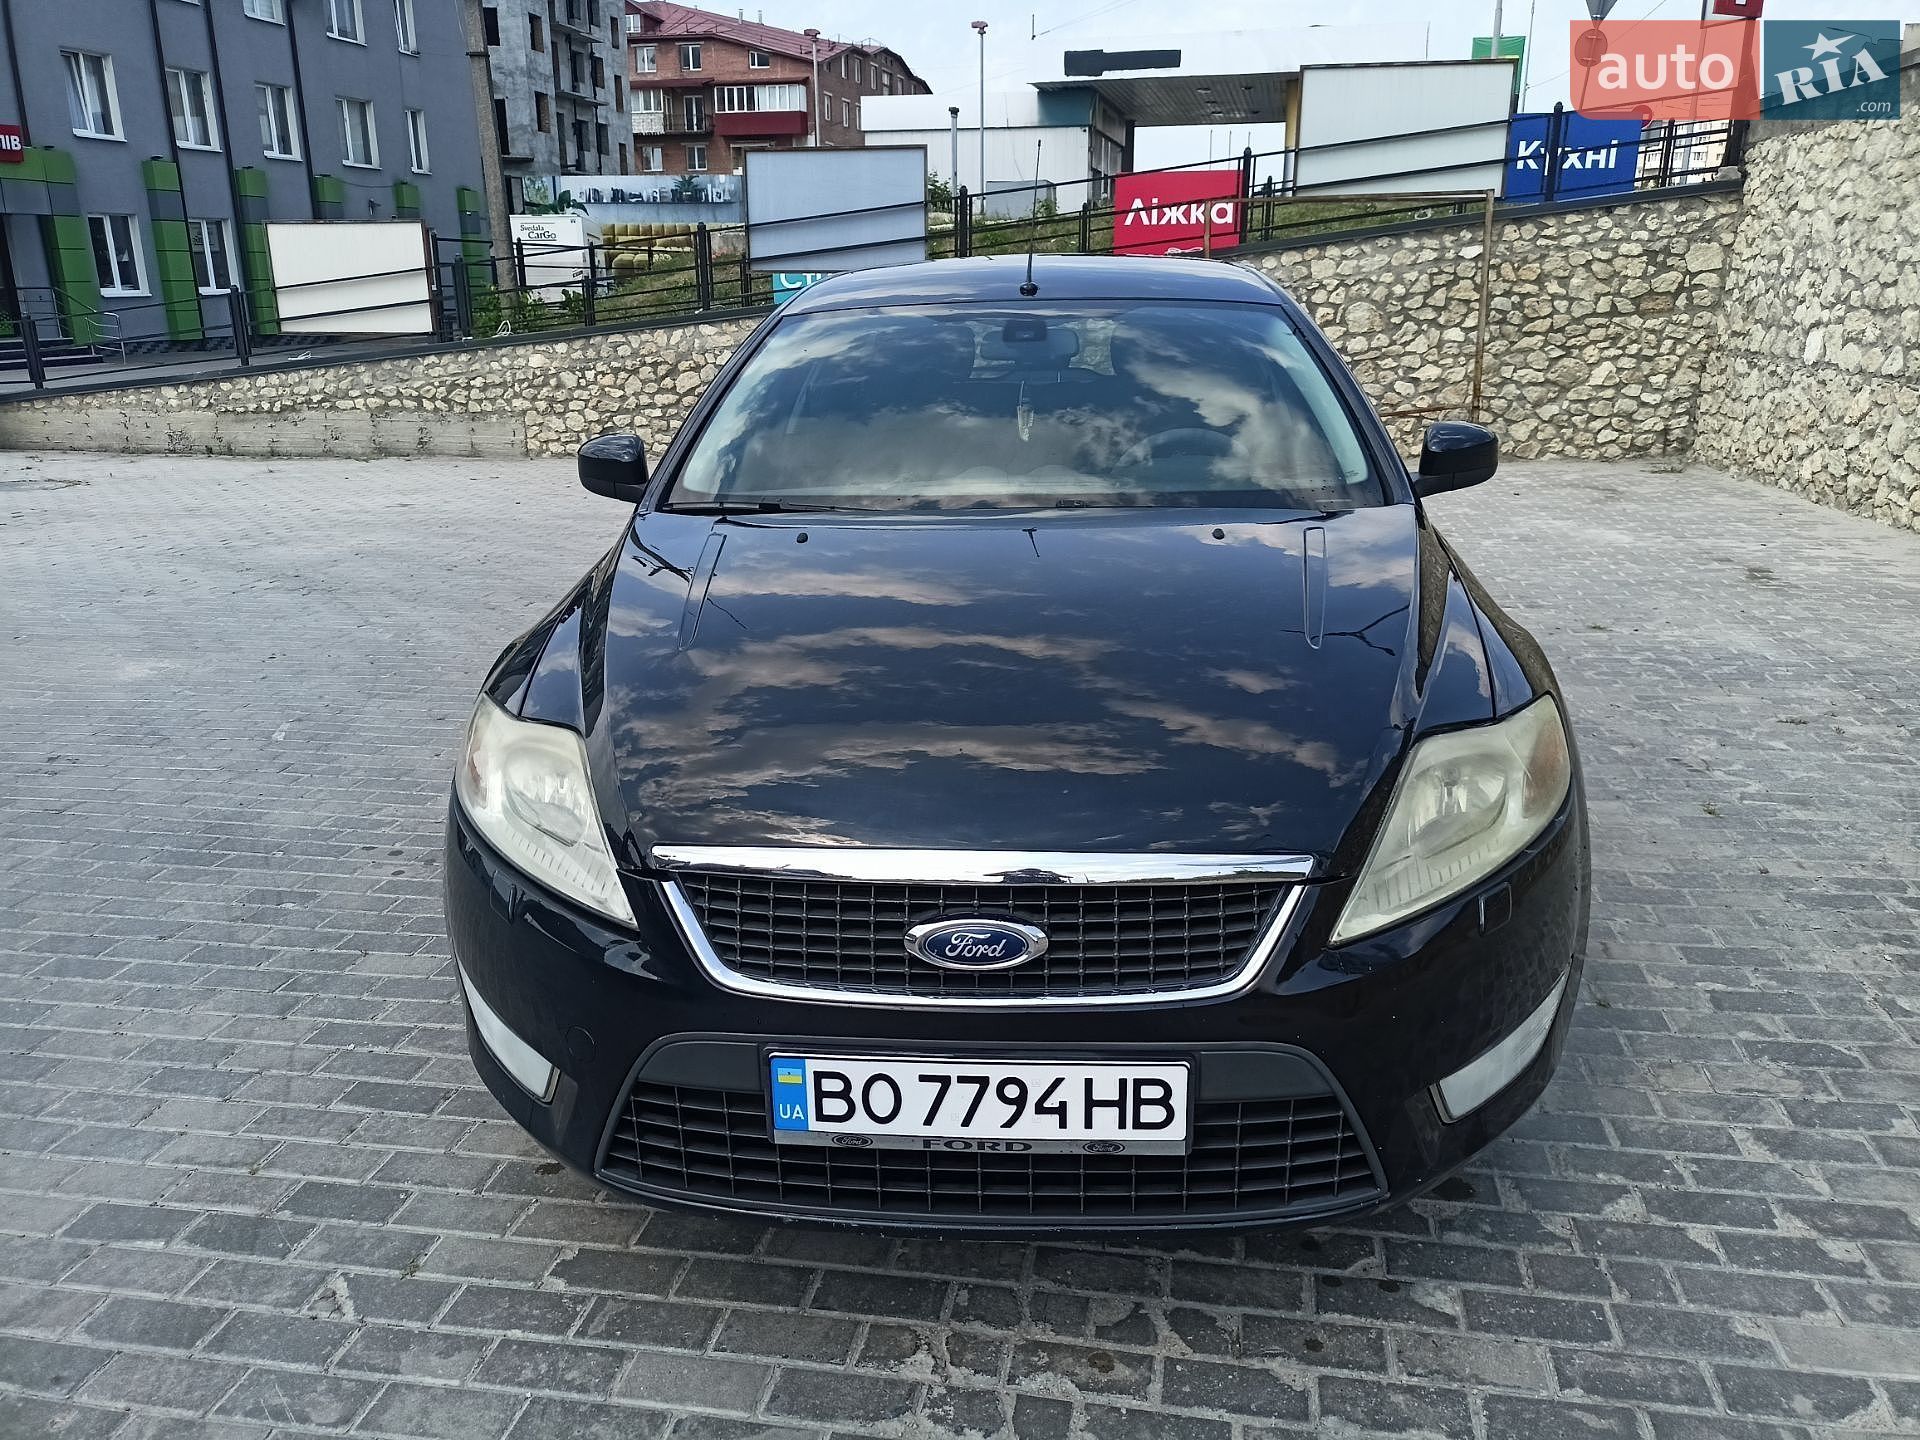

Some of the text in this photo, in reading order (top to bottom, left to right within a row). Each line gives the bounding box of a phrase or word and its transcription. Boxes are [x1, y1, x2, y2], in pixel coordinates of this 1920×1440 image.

[1123, 197, 1234, 226] Ліжка
[520, 224, 545, 232] Svedala
[527, 230, 557, 240] CarGo
[945, 932, 1007, 958] Ford
[813, 1070, 1175, 1130] BO 7794 HB
[779, 1103, 805, 1121] UA
[922, 1138, 1033, 1152] FORD
